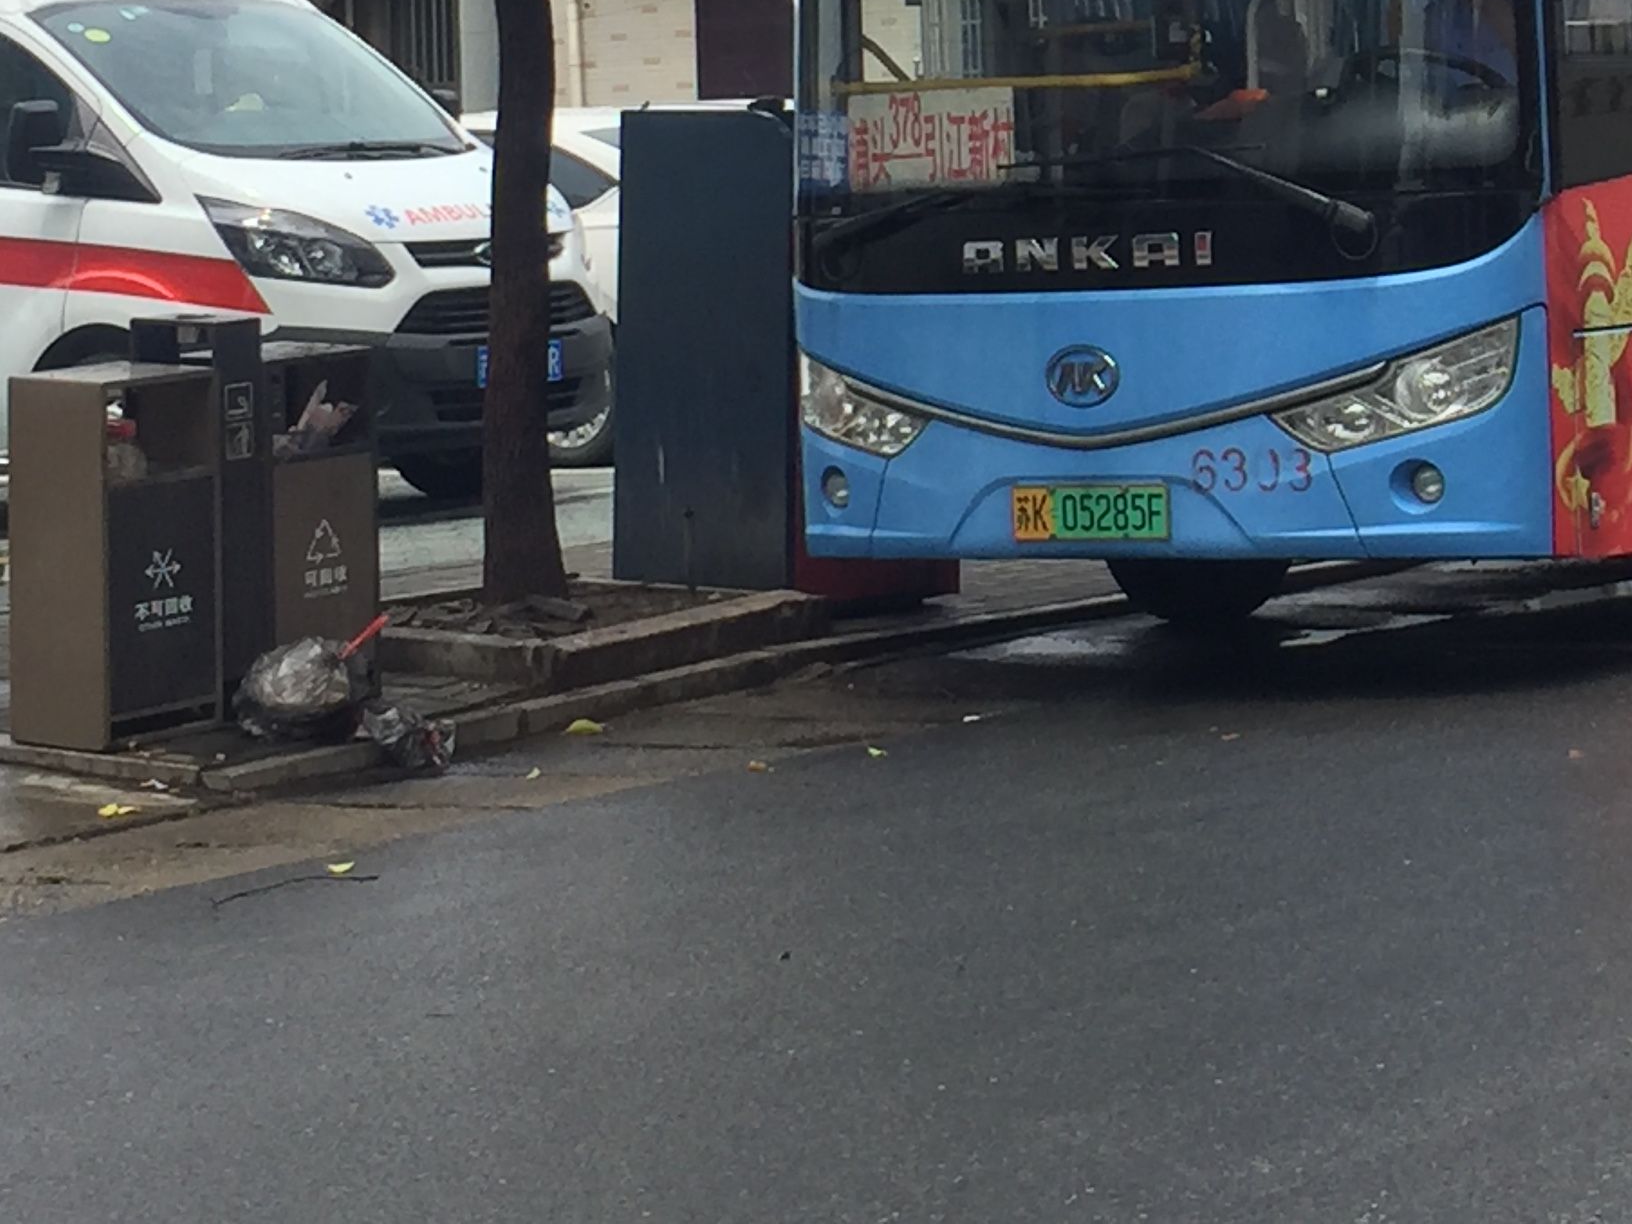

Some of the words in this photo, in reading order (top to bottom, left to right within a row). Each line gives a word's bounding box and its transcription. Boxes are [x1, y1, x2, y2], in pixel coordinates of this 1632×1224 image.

[889, 92, 921, 149] 378
[404, 203, 491, 226] AMBUL
[963, 231, 1212, 273] ANKAI
[304, 565, 348, 587] 可回收
[134, 594, 194, 621] 不可回收
